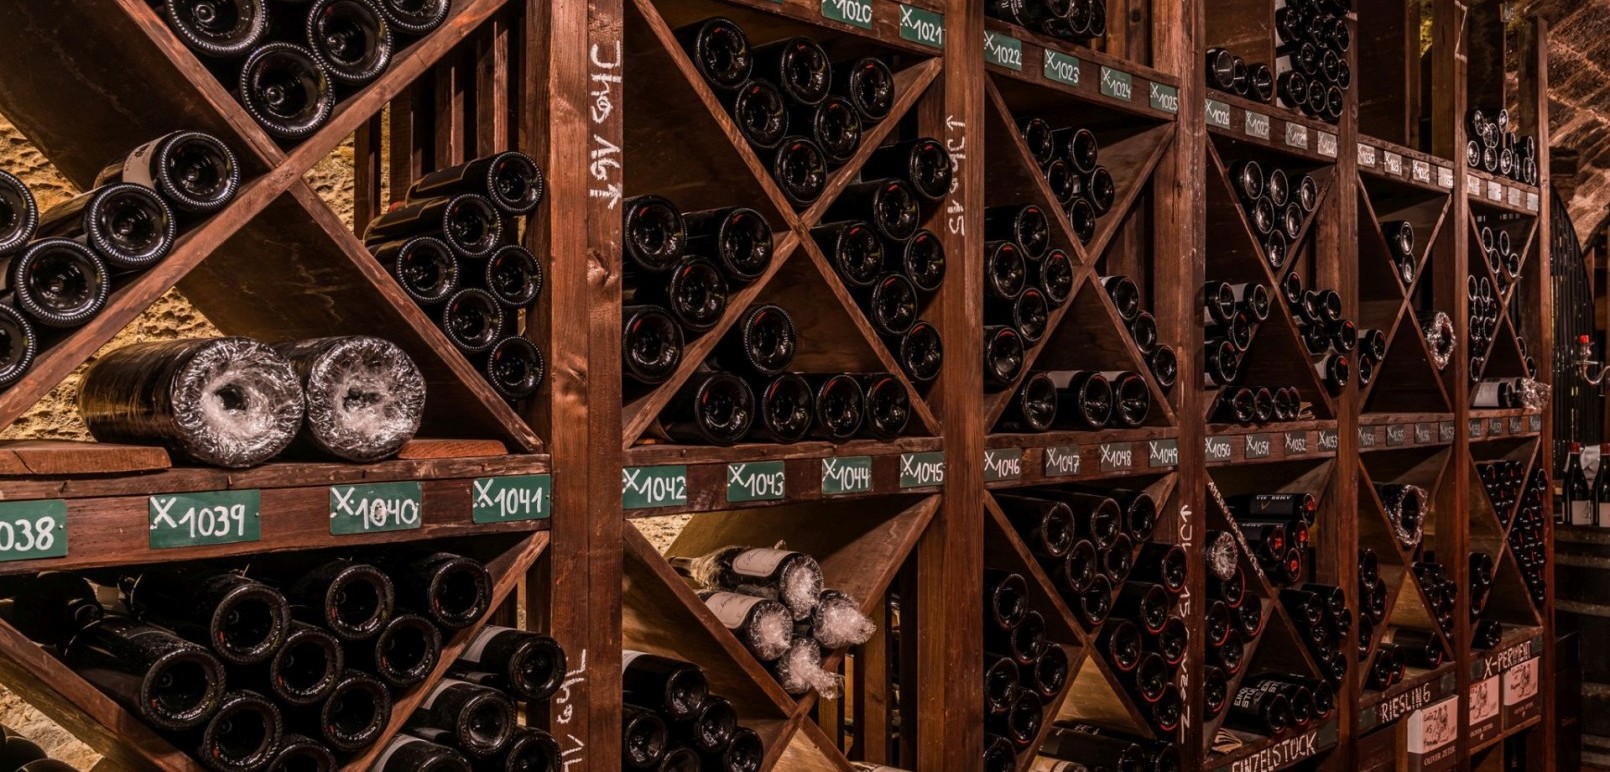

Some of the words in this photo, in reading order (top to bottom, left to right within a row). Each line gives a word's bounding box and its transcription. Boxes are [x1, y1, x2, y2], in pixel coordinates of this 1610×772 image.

[822, 0, 872, 24] 1020
[900, 453, 944, 484] X1045
[984, 451, 1021, 478] X1046
[1046, 448, 1080, 473] X1047
[1100, 443, 1132, 467] X1048
[1149, 441, 1179, 464] X1049
[622, 468, 687, 503] X1042
[728, 463, 785, 497] X1043
[822, 458, 870, 491] X1044
[473, 479, 543, 517] X1041
[150, 496, 246, 538] X1039
[1381, 683, 1431, 723] RIESLING
